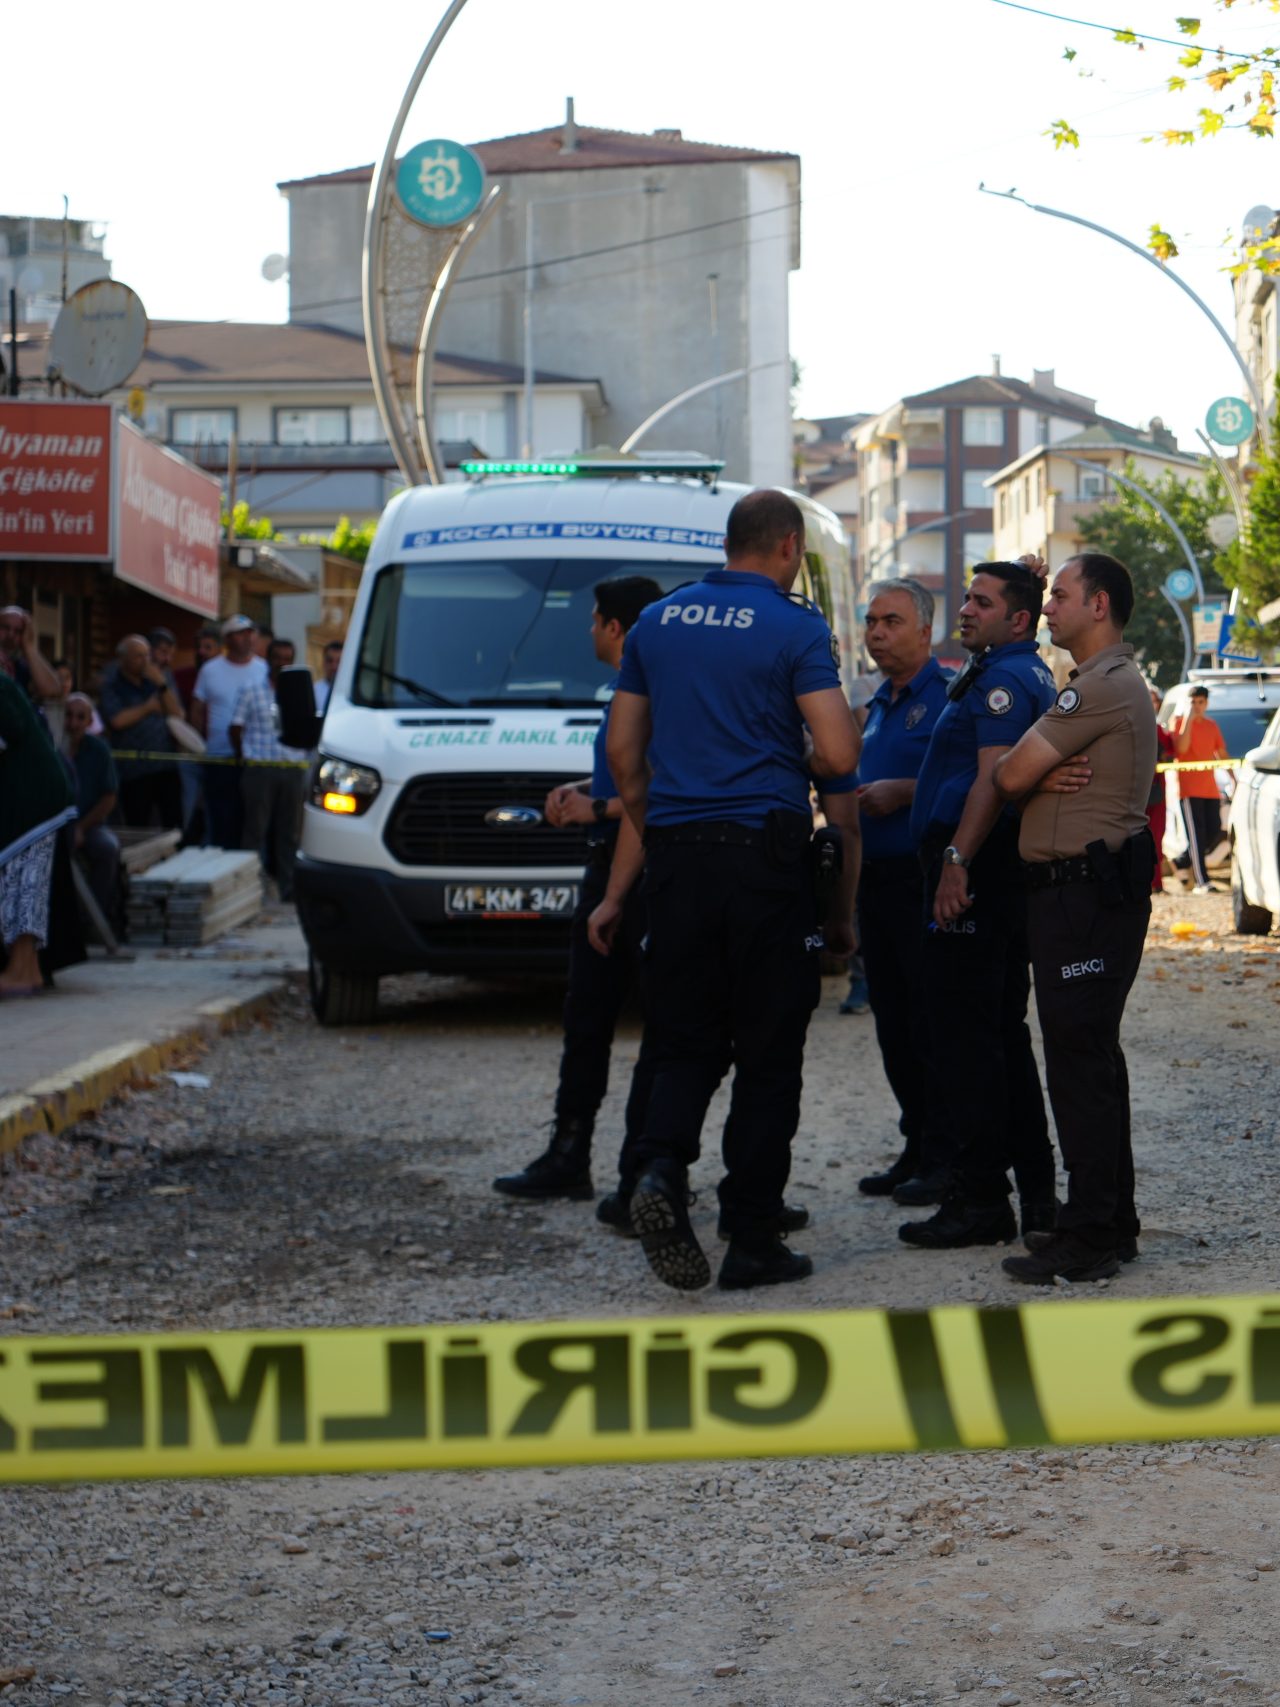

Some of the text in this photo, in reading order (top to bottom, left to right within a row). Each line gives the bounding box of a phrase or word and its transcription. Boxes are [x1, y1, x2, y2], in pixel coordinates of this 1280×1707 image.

[0, 426, 103, 460] ıyaman
[51, 509, 95, 534] Yeri
[438, 524, 553, 542] KOCAELİ
[409, 731, 491, 748] CENAZE
[498, 729, 557, 745] NAKİL
[452, 886, 571, 912] 41 KM 347
[932, 920, 976, 935] OLİS
